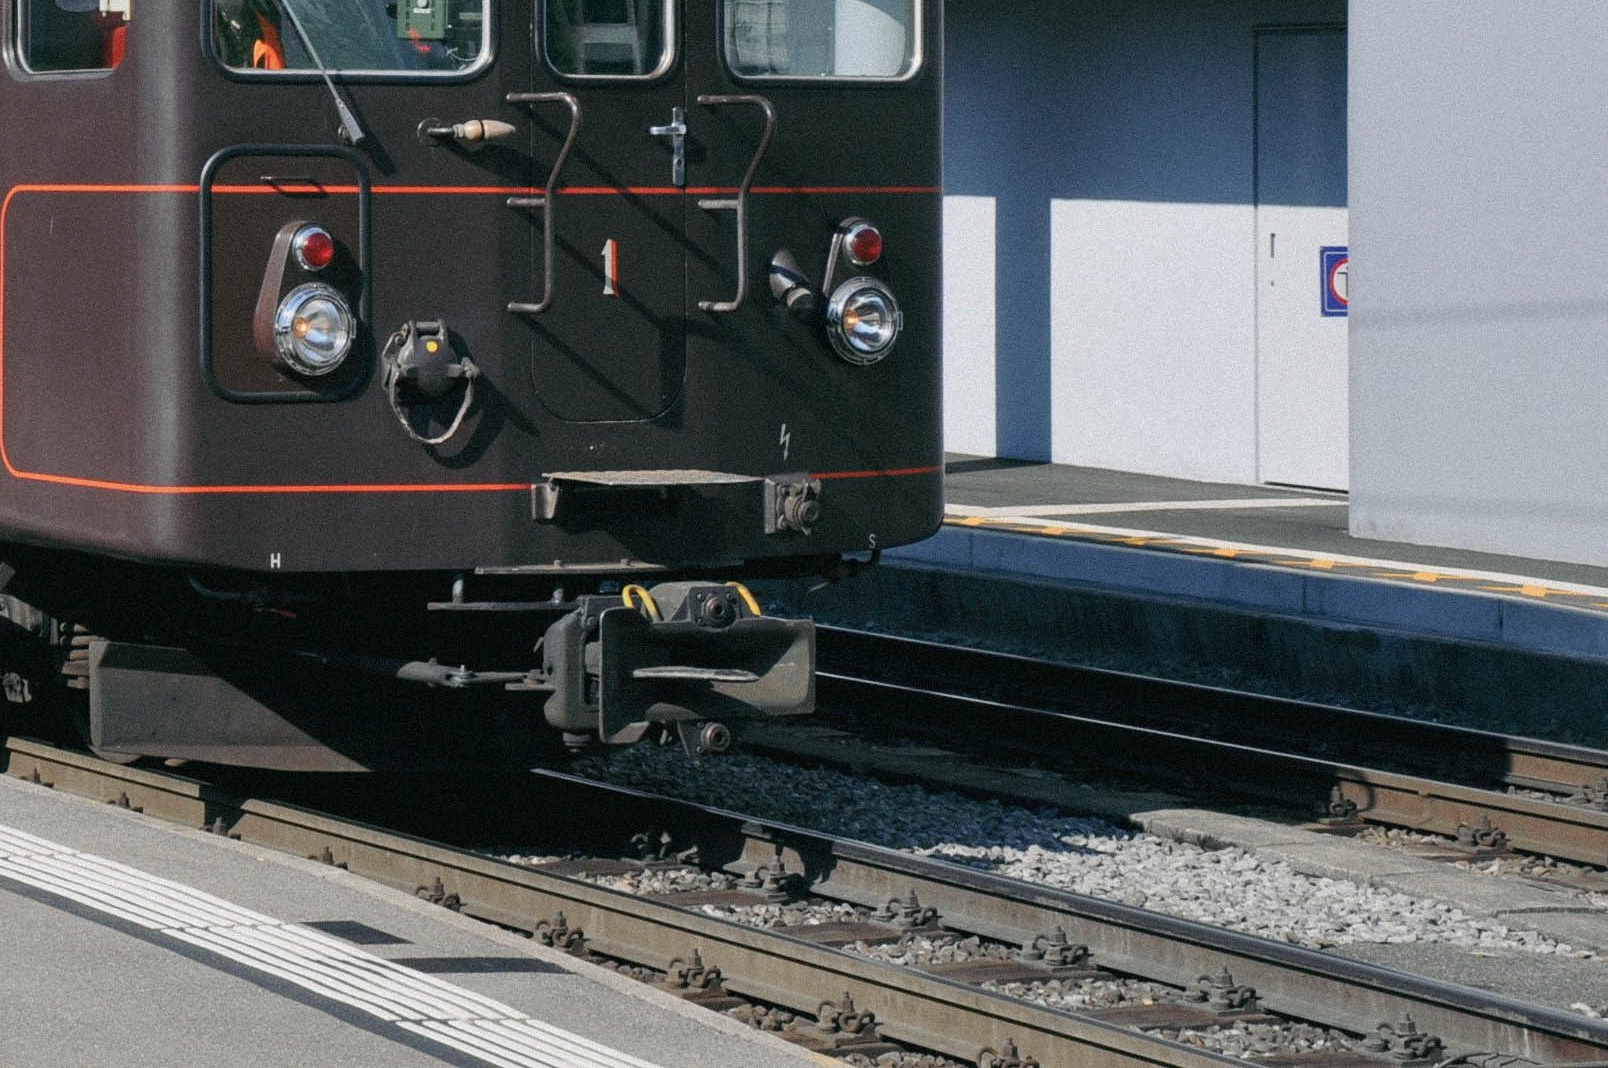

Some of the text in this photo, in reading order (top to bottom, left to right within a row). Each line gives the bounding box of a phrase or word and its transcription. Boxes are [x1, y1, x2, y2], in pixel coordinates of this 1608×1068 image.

[601, 239, 618, 297] 1
[869, 533, 876, 548] S
[270, 553, 281, 569] H
